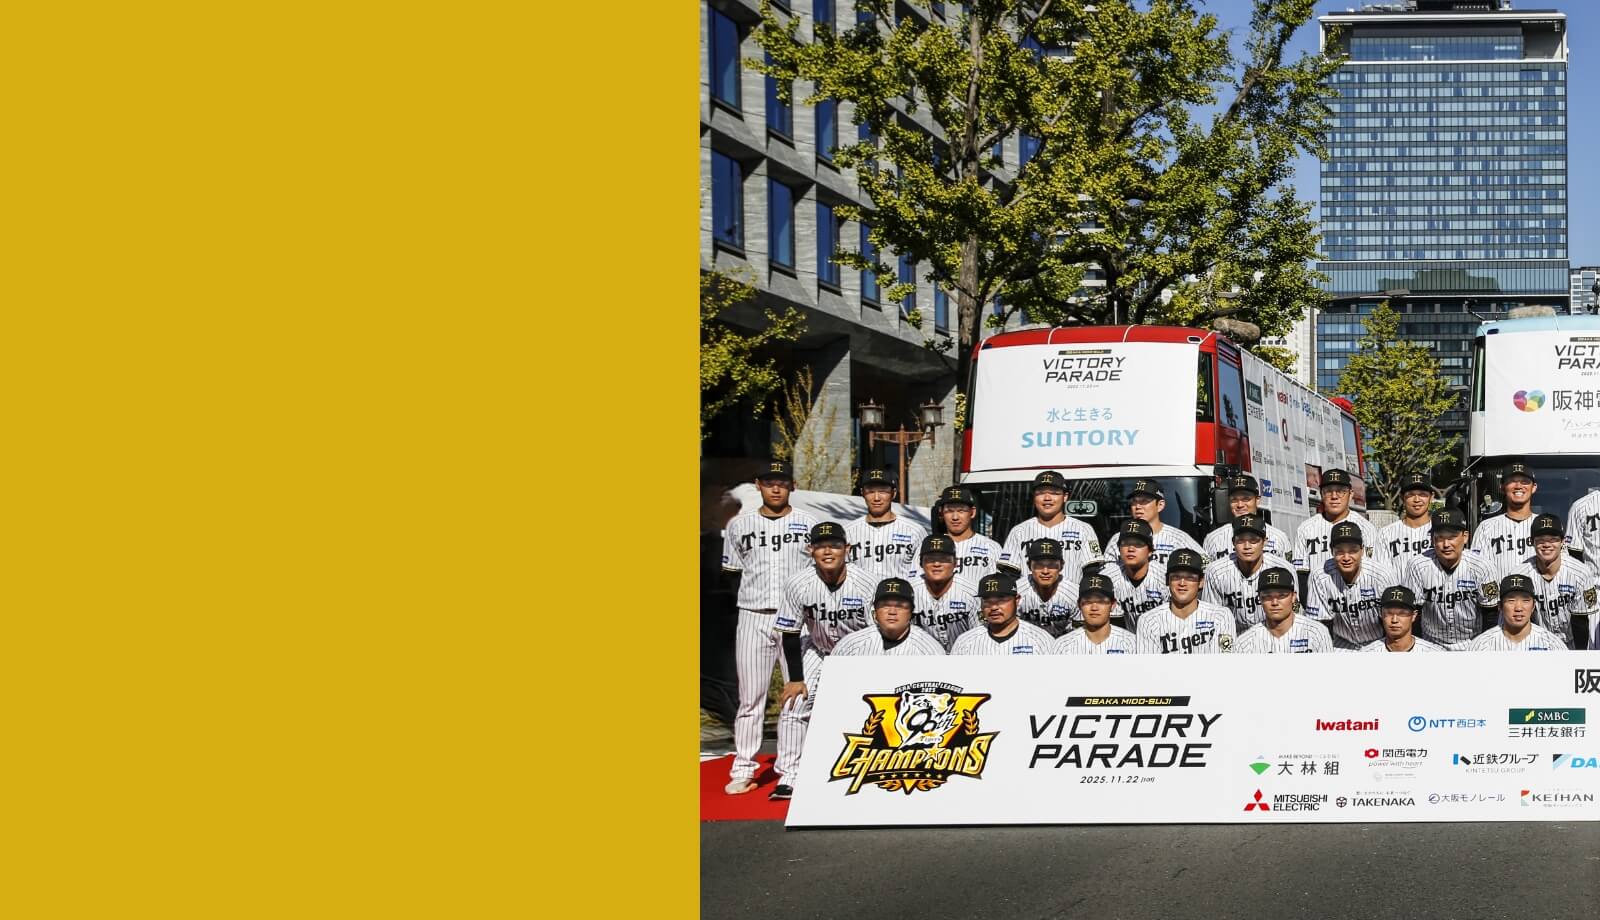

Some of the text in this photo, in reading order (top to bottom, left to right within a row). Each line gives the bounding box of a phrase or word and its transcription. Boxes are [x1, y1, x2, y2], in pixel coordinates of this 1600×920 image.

[1043, 357, 1126, 370] VICTORY
[1045, 370, 1122, 383] PARADE
[1046, 407, 1113, 422] 水と生きる
[1021, 429, 1139, 449] SUNTORY
[742, 531, 811, 551] Tigers
[1389, 538, 1434, 557] Tige
[1491, 534, 1534, 555] Tige
[850, 541, 913, 562] Tigers
[955, 553, 989, 574] gers
[803, 603, 865, 628] Tigers
[1160, 628, 1215, 654] Tigers
[1537, 711, 1570, 721] SMBC
[1029, 714, 1223, 738] VICTORY
[1316, 719, 1379, 731] Iwatani
[1508, 727, 1585, 738] 三井住友銀行
[1028, 743, 1212, 768] PARADE
[1383, 748, 1427, 757] 関西電力
[1473, 754, 1539, 765] 近鉄グループ
[831, 733, 990, 793] CHAMPIONS
[1278, 760, 1340, 775] 大林組
[1080, 775, 1139, 784] 2025.11.22
[1274, 794, 1328, 803] MITSUBISHI
[1351, 798, 1415, 806] TAKENAKA
[1441, 793, 1506, 802] 大阪モノレール
[1273, 803, 1320, 812] ELECTRIC
